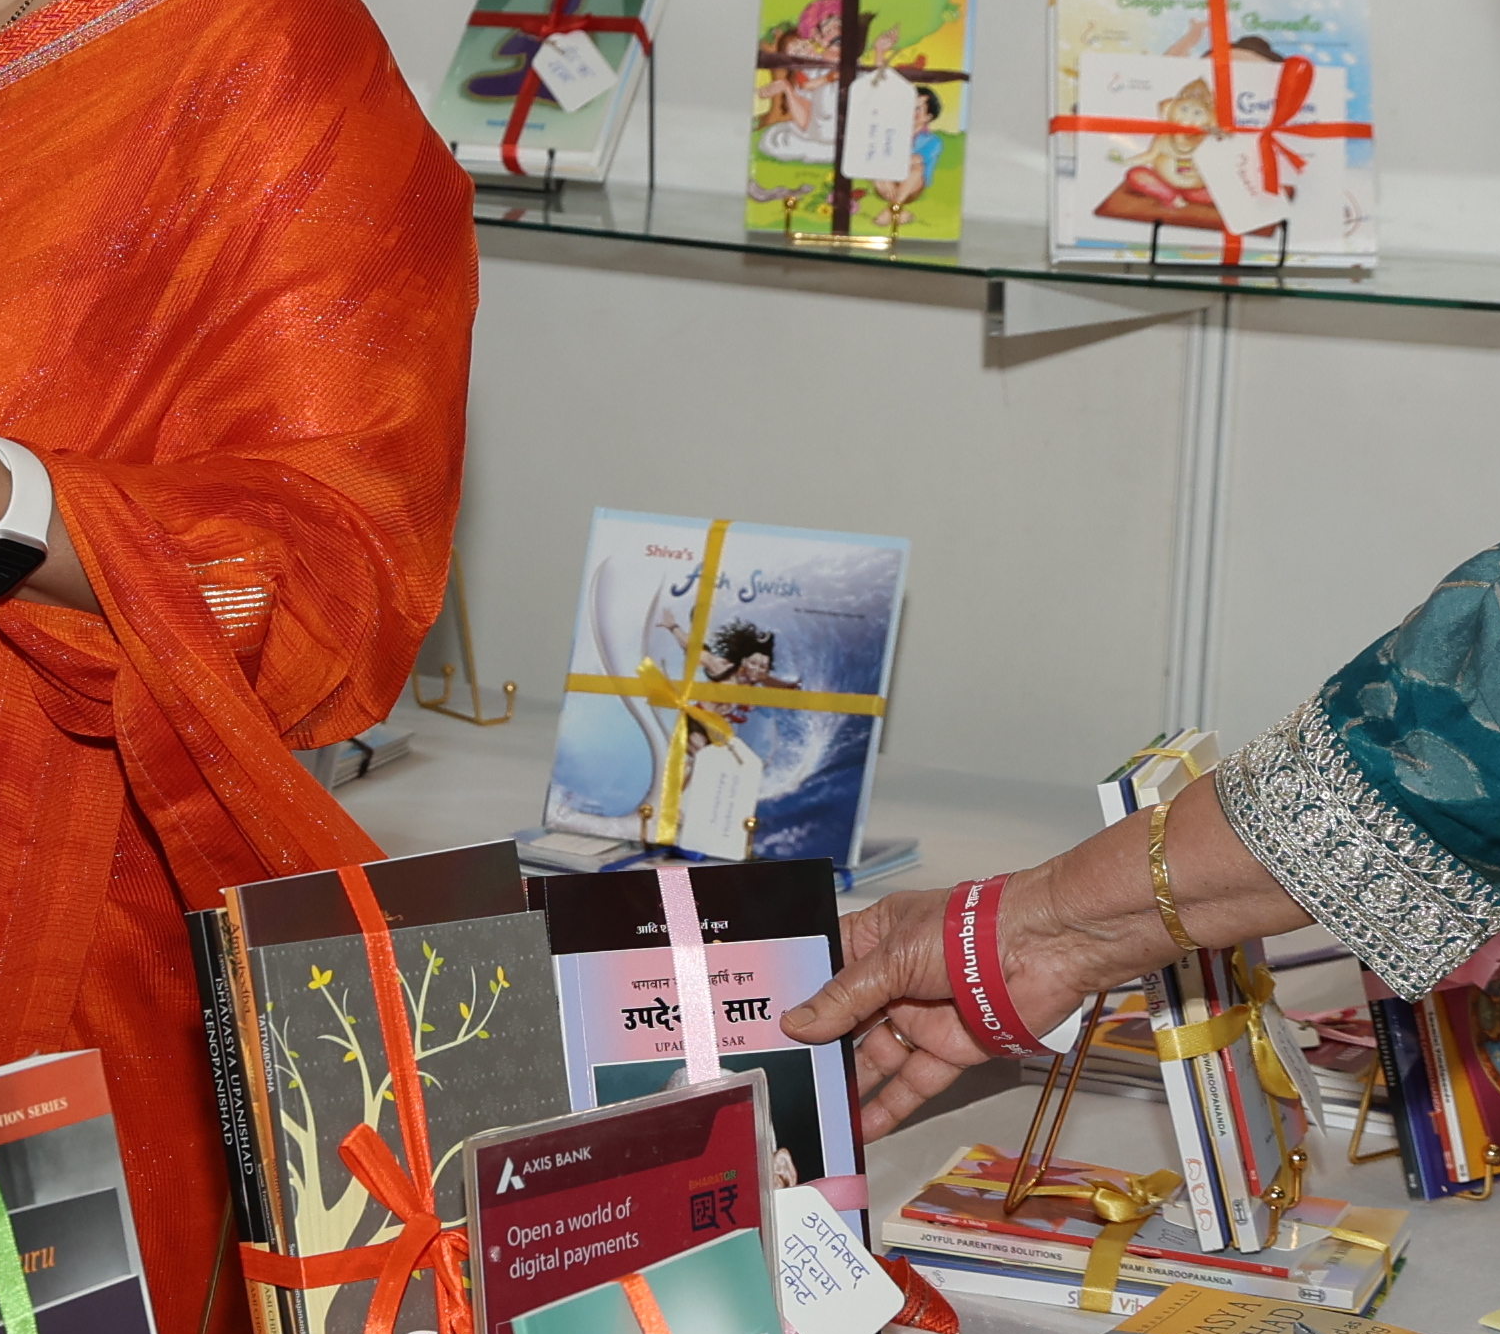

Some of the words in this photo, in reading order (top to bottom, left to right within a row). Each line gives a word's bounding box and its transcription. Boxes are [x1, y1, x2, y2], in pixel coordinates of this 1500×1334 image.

[644, 542, 695, 562] Shiva's
[737, 568, 803, 604] Swish
[228, 921, 251, 1015] Atmabodha
[958, 911, 981, 985] Mumbai
[631, 977, 671, 992] भगवान
[969, 985, 1001, 1031] Chant
[1142, 971, 1165, 1022] Shishu
[721, 997, 773, 1024] सार
[256, 1013, 276, 1094] TATTVABODHA
[721, 1035, 747, 1047] SAR
[202, 1008, 233, 1147] KENOPANISHAD
[214, 977, 237, 1068] ISHAVASYA
[229, 1074, 254, 1176] UPANISHAD
[1202, 1052, 1228, 1138] WAROOPANANDA
[26, 1096, 69, 1121] SERIES
[522, 1153, 553, 1177] AXIS
[556, 1146, 593, 1169] BANK
[506, 1221, 553, 1250] Open
[555, 1218, 565, 1235] a
[568, 1201, 612, 1234] world
[615, 1195, 633, 1221] of
[509, 1247, 561, 1282] digital
[563, 1230, 640, 1269] payments
[919, 1232, 956, 1248] JOYFUL
[957, 1236, 1009, 1255] PARENTING
[1010, 1243, 1064, 1262] SOLUTIONS
[1117, 1260, 1145, 1276] WAMI
[1146, 1264, 1234, 1288] SWAROOPANANDA
